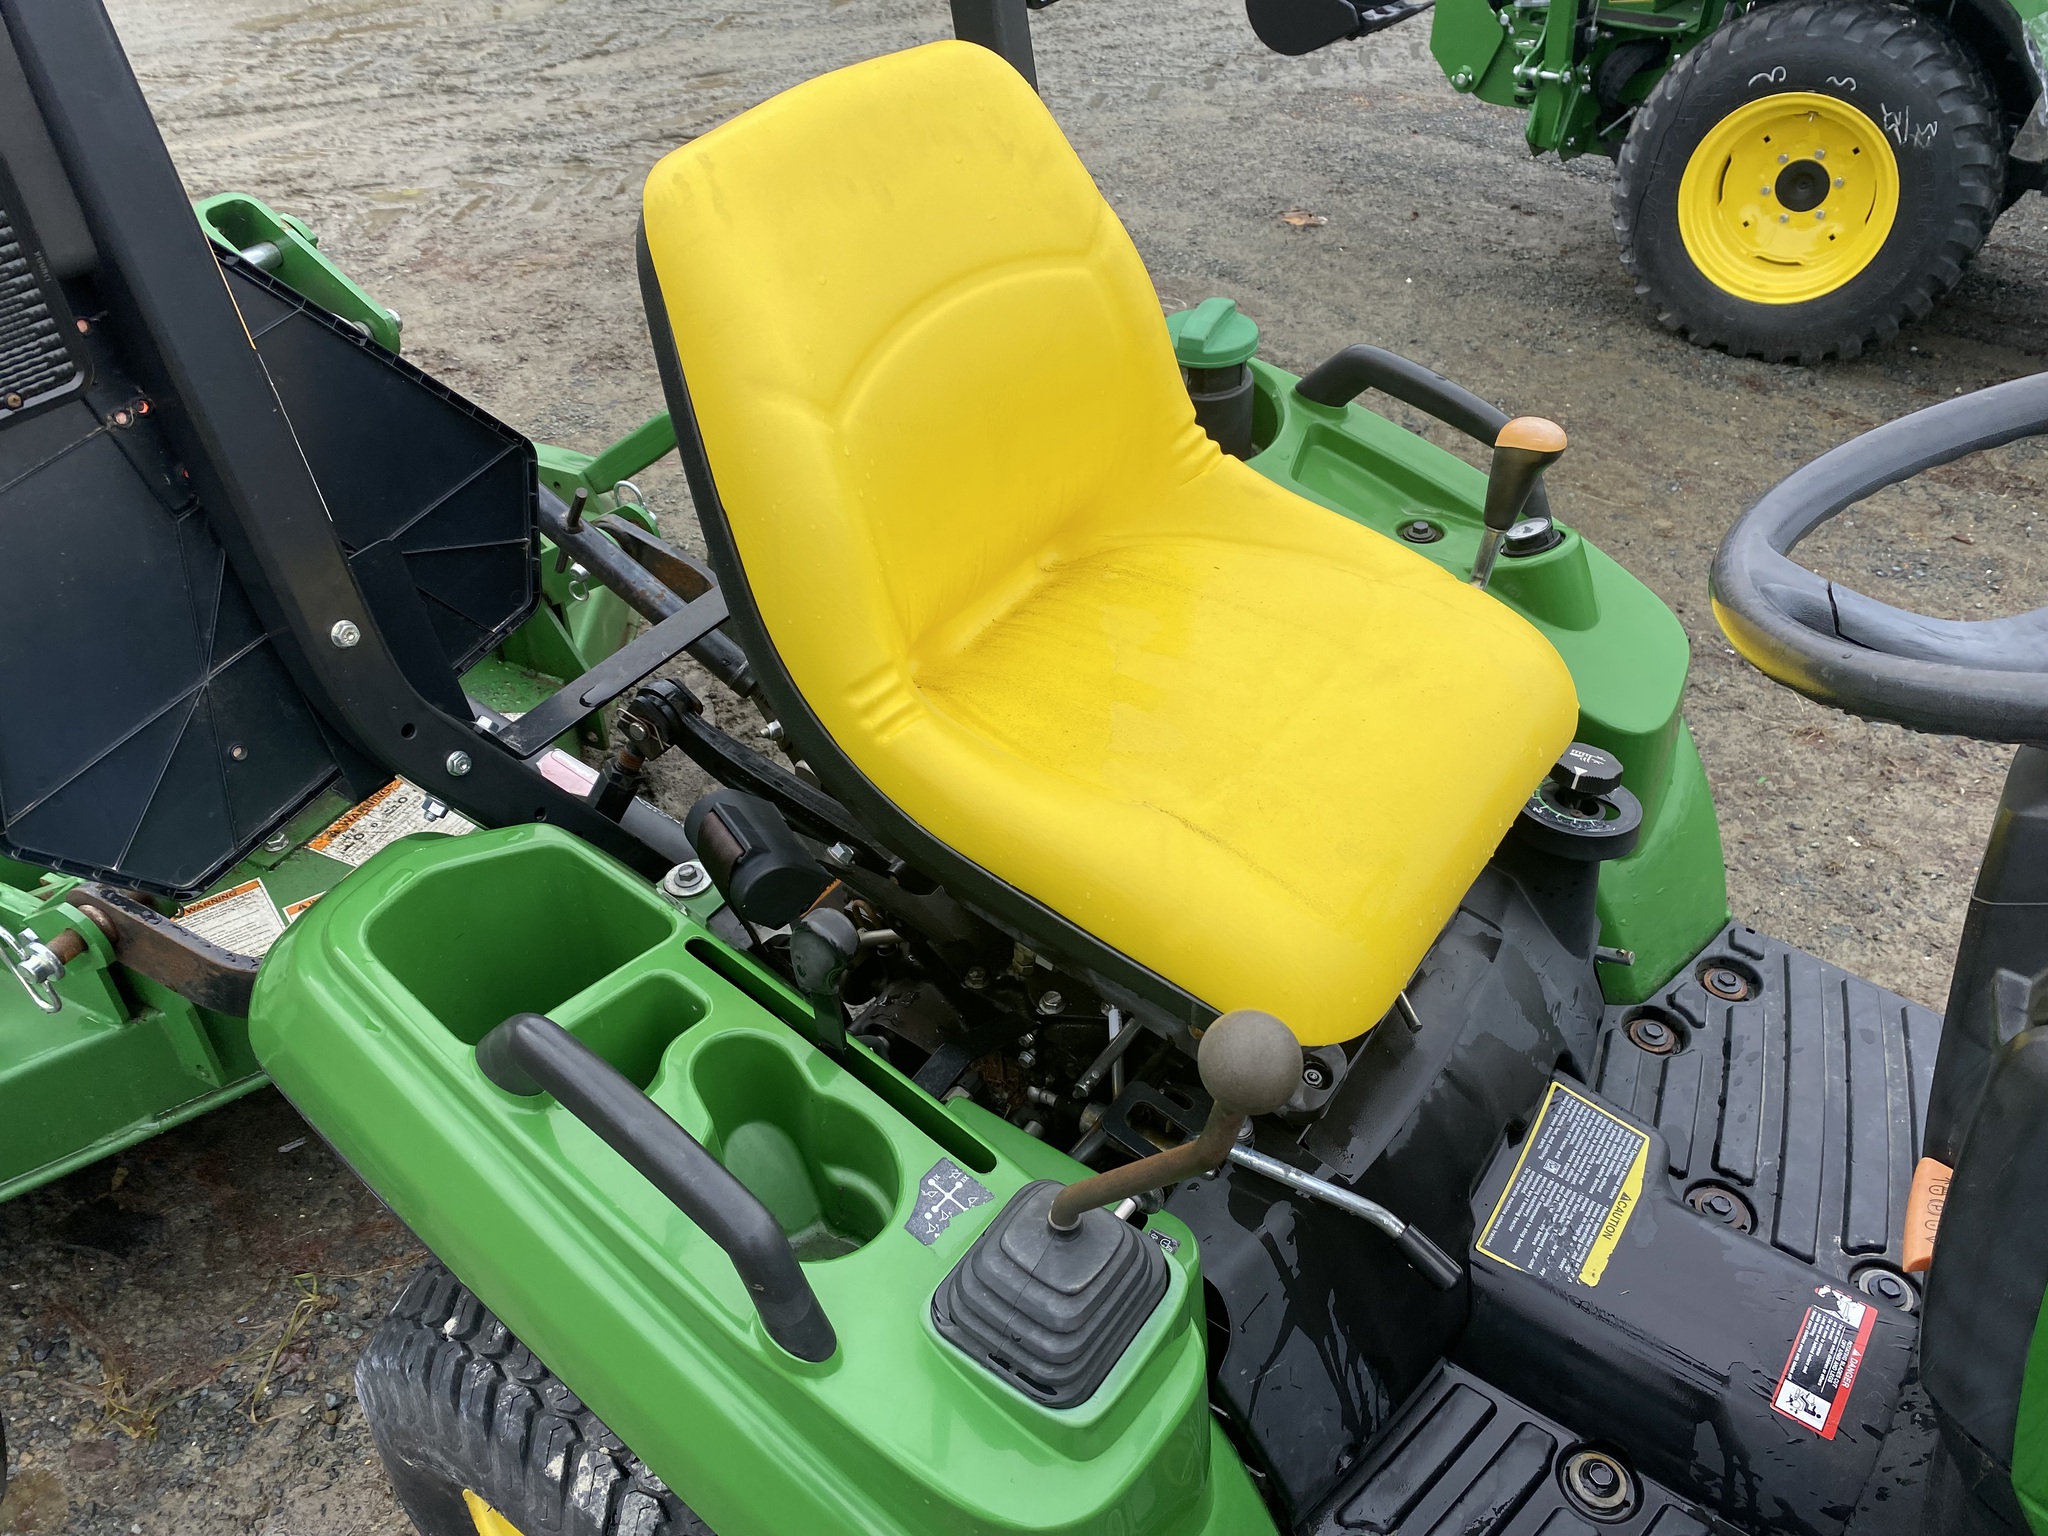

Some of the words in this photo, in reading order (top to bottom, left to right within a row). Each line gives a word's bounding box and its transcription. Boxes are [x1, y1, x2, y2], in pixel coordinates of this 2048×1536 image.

[185, 890, 238, 914] WARNING
[1602, 1201, 1629, 1240] CAUTION
[1842, 1357, 1858, 1388] DANGER
